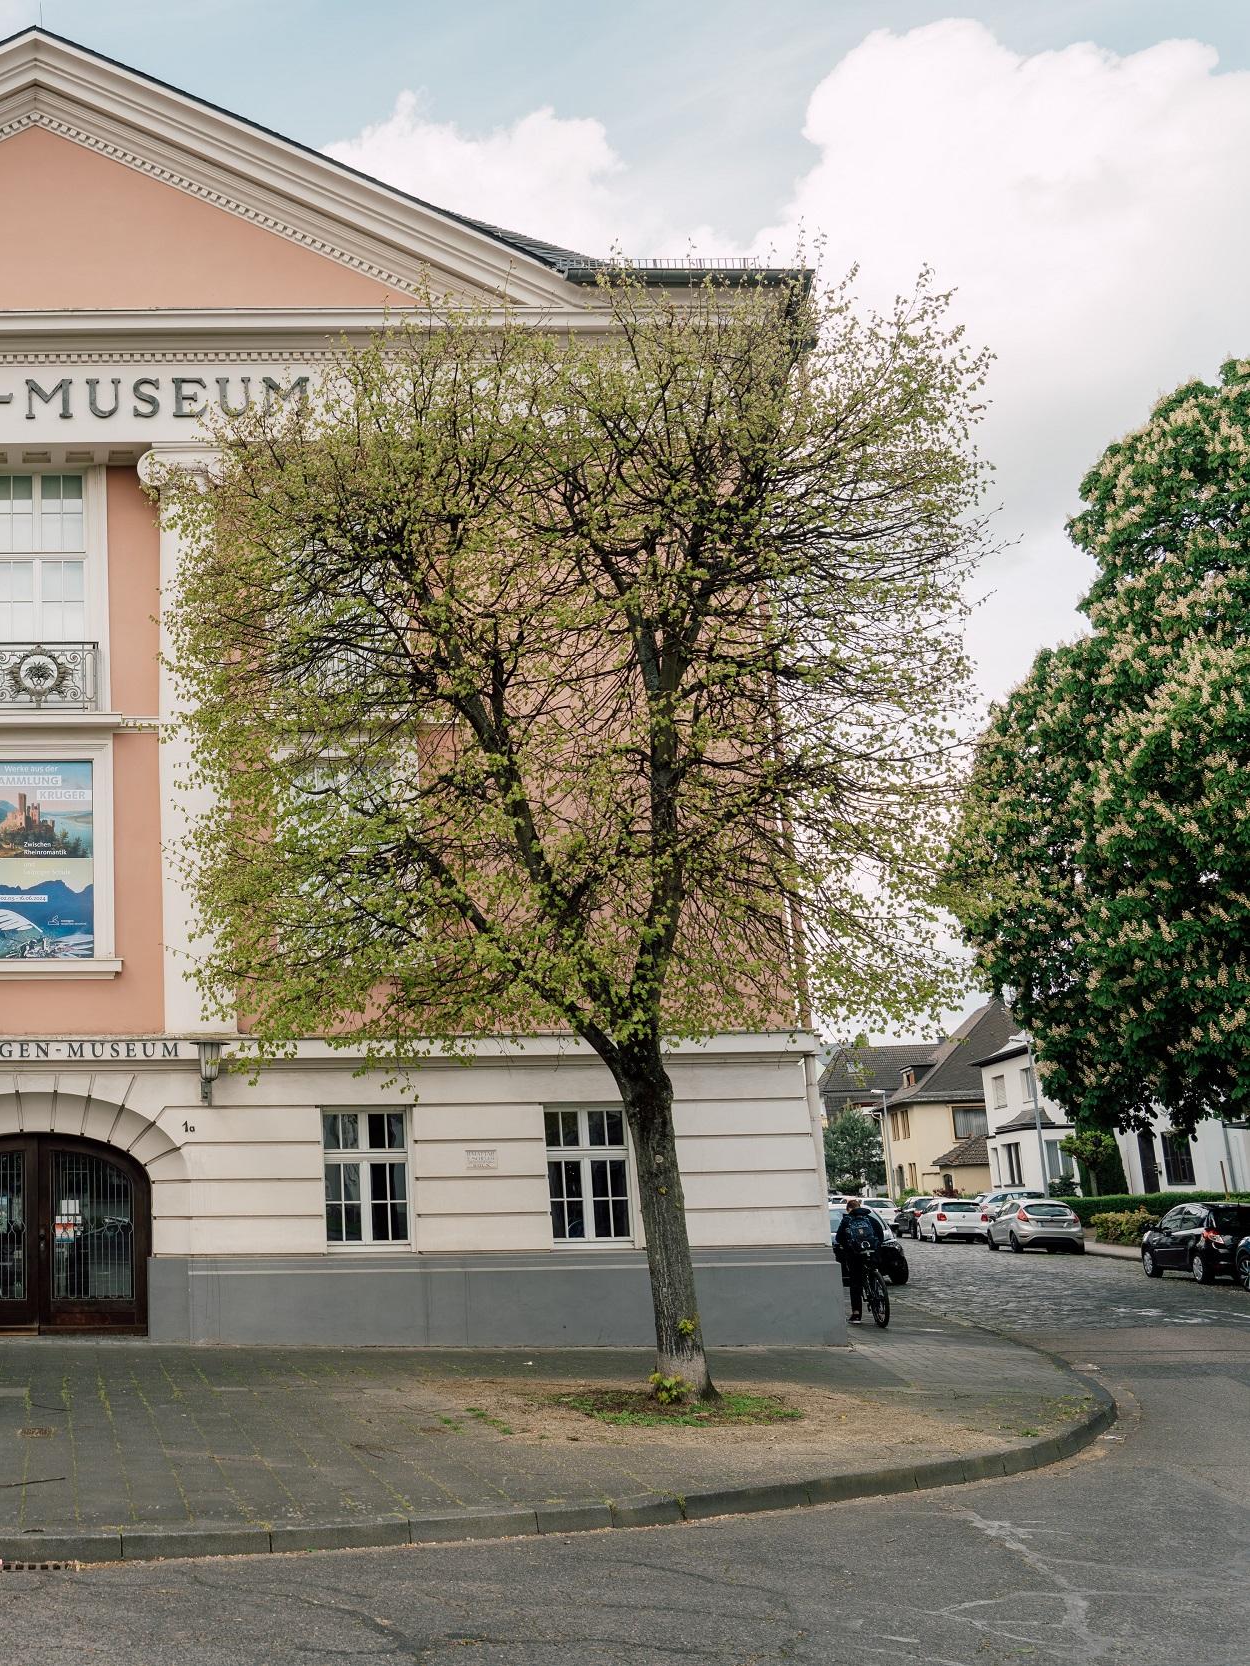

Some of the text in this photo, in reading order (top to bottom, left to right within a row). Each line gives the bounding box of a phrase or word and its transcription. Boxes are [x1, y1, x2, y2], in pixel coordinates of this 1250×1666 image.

[4, 765, 28, 773] Werke
[45, 764, 59, 773] der
[182, 1120, 196, 1133] 1a
